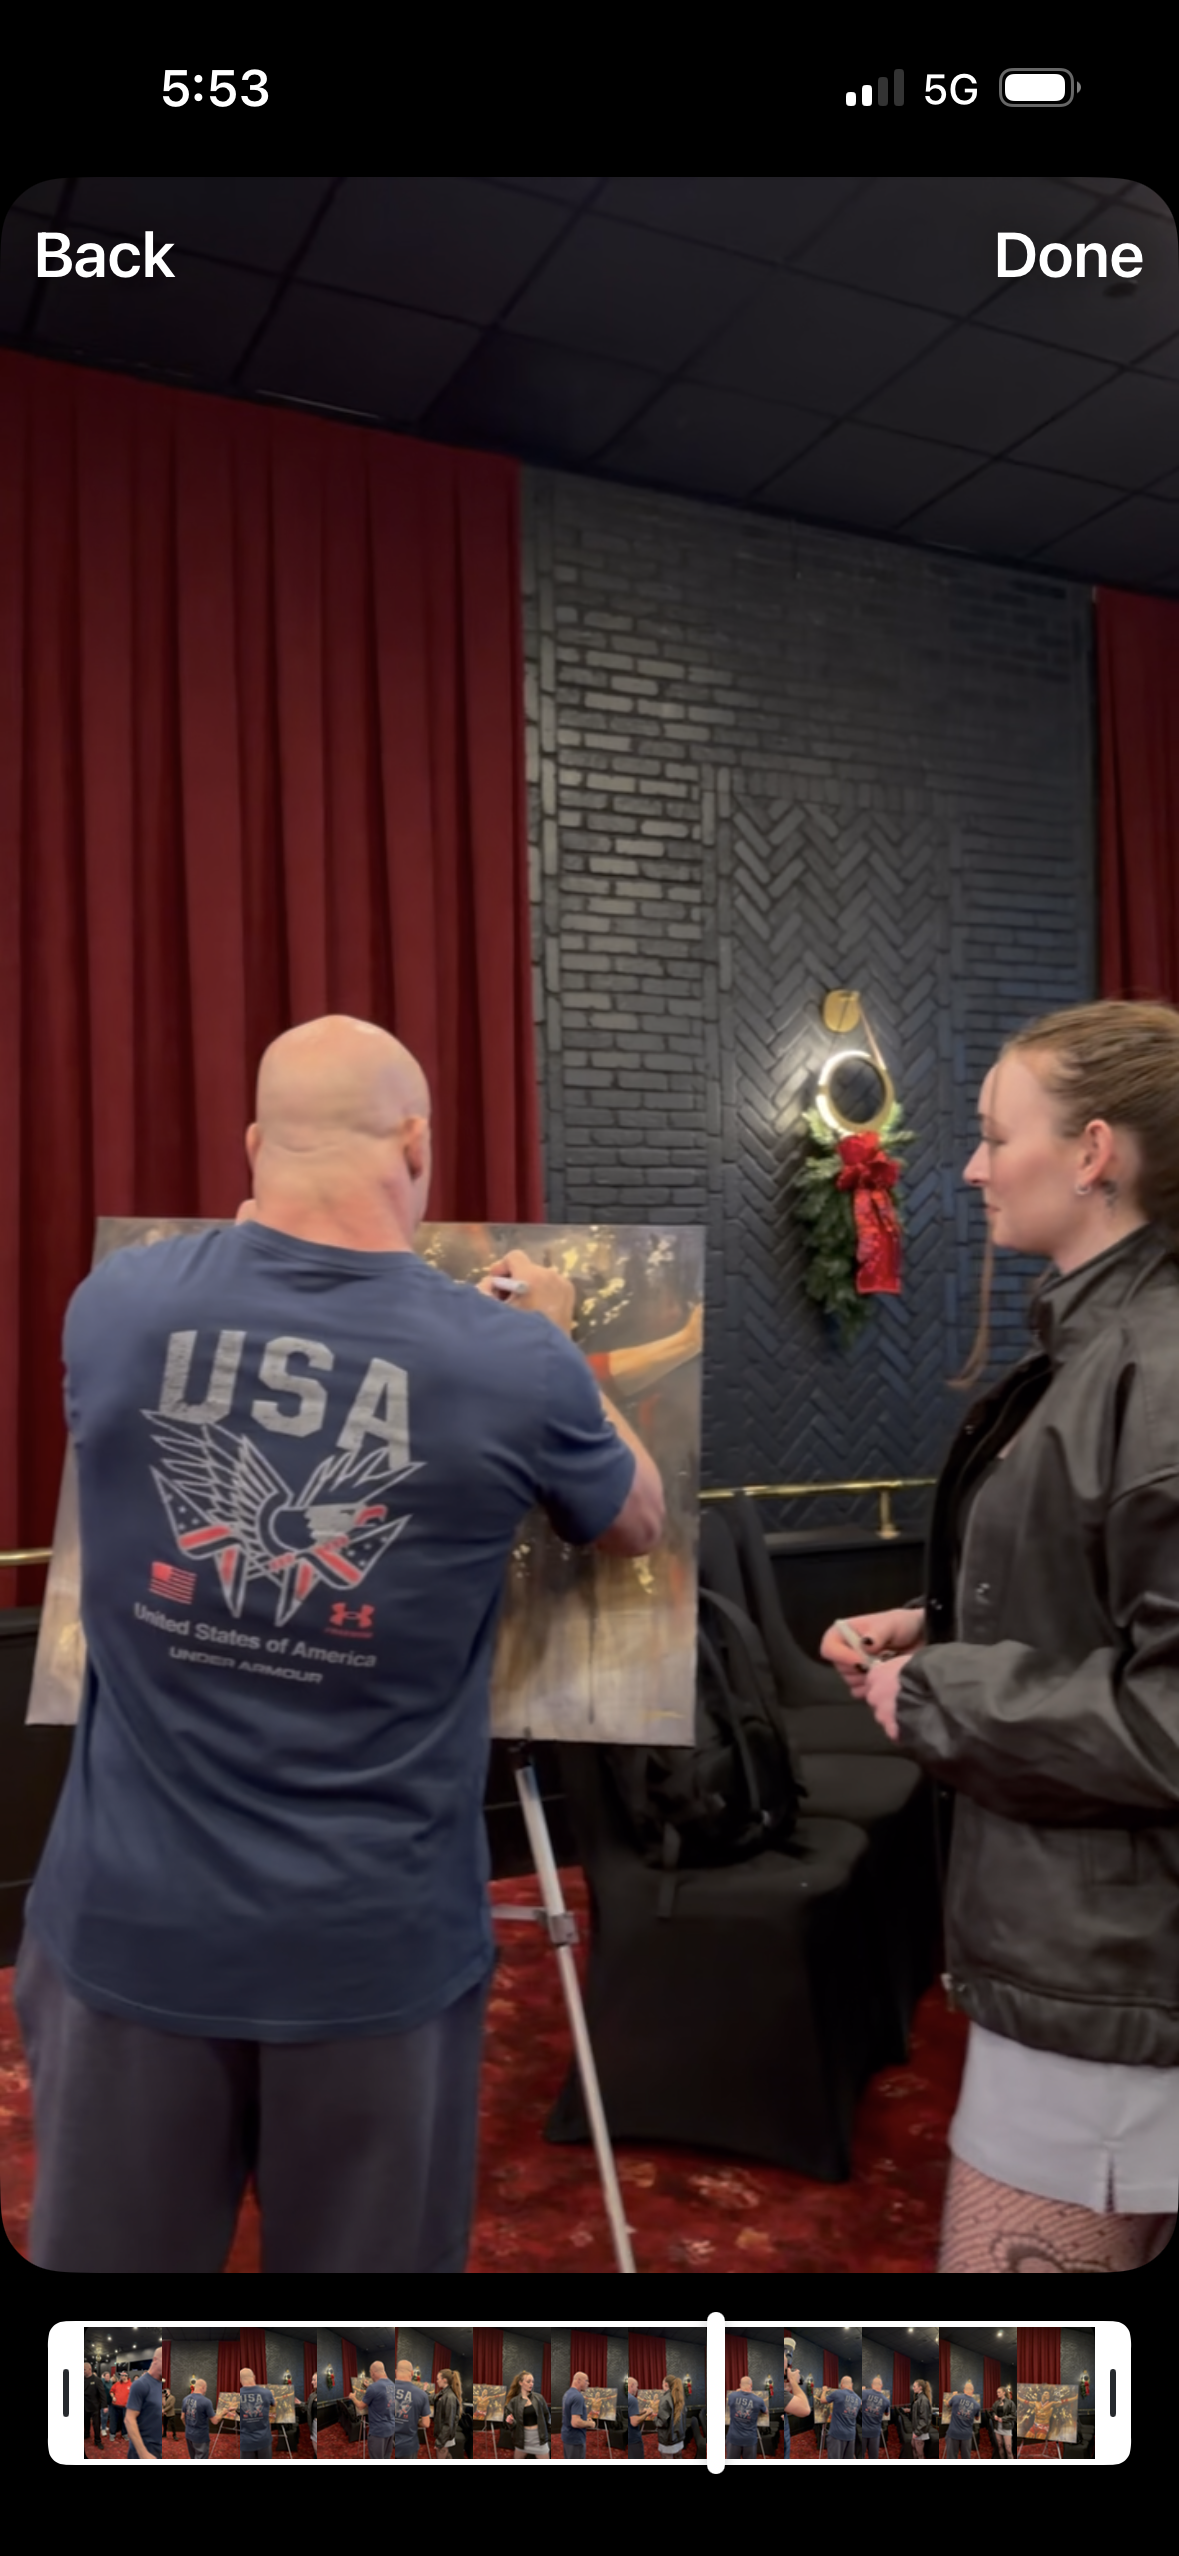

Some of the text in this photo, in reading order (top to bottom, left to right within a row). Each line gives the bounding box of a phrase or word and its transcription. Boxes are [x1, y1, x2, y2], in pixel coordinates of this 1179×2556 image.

[158, 1330, 411, 1471] USA
[133, 1602, 378, 1667] United States of America
[169, 1646, 323, 1683] UNDER ARMOUR
